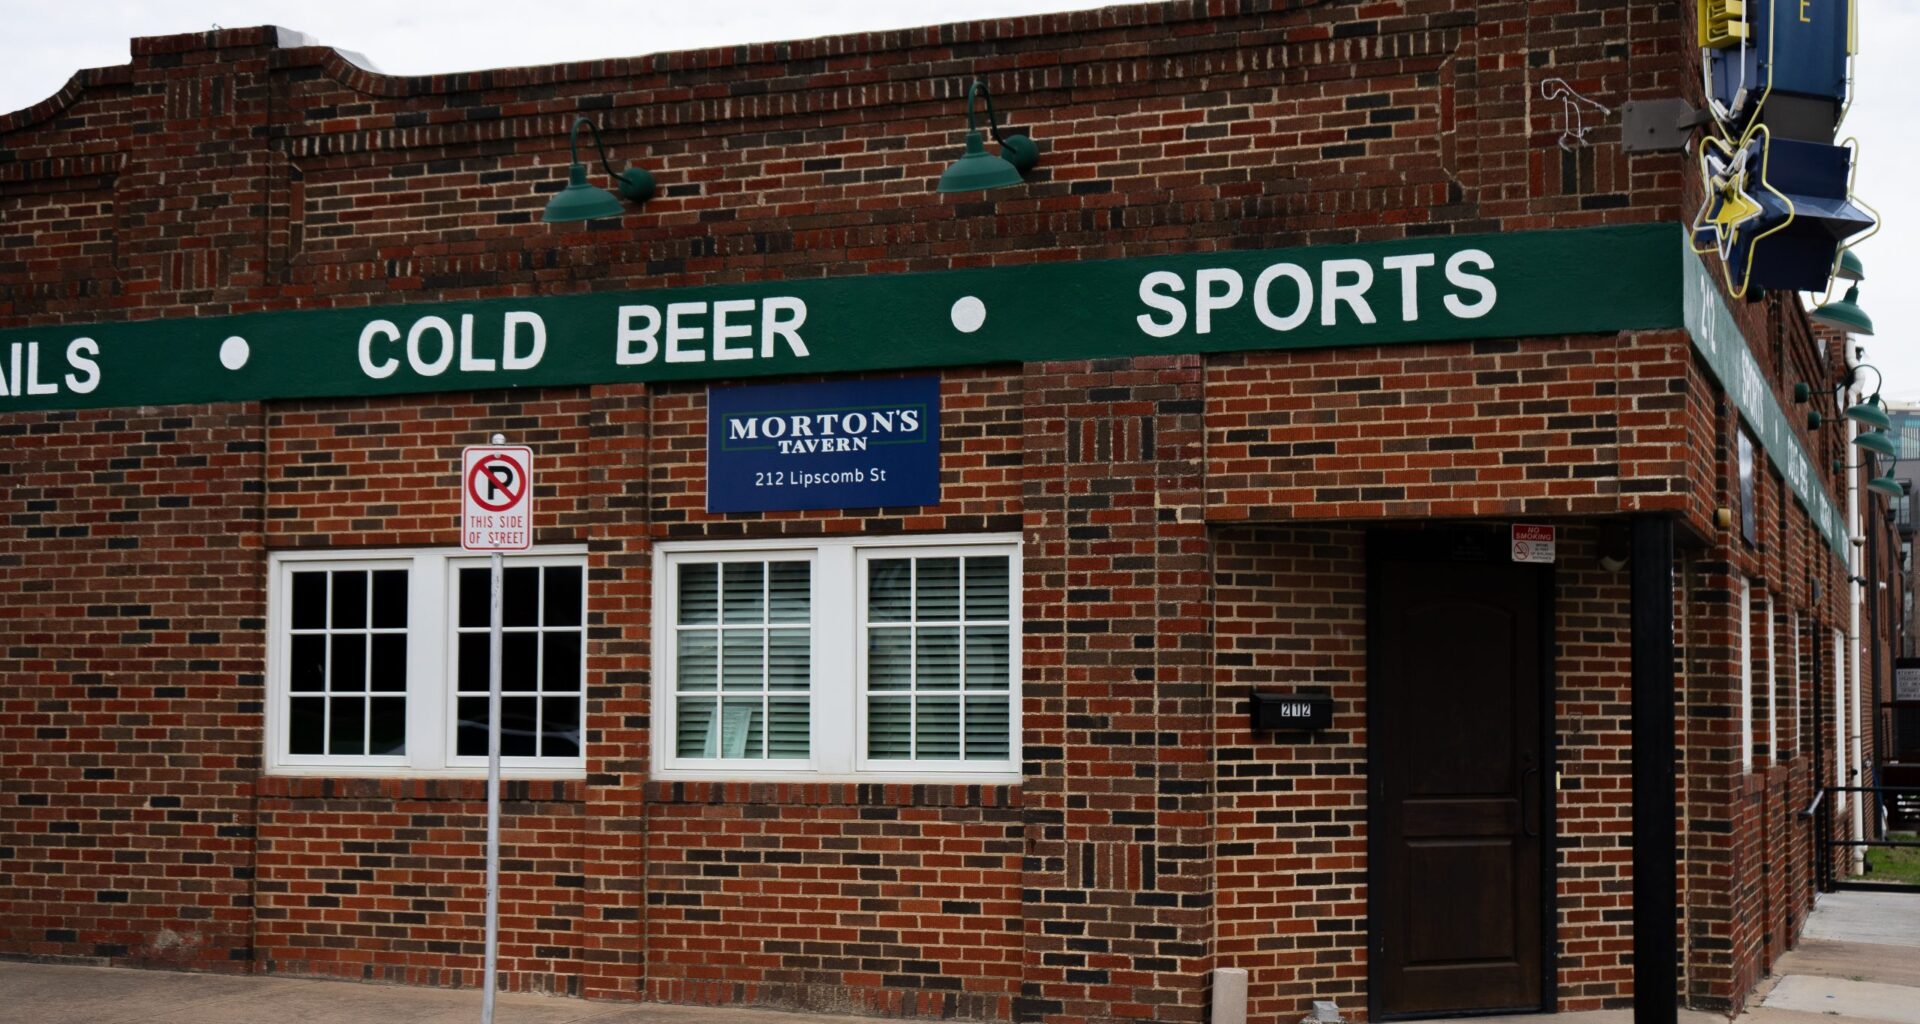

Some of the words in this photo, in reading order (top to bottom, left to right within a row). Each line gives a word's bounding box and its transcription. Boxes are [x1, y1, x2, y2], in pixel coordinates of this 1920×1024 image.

[0, 338, 100, 397] ILS
[358, 311, 547, 379] COLD
[615, 296, 810, 366] BEER
[1137, 249, 1497, 338] SPORTS
[1700, 274, 1716, 355] 212
[729, 409, 919, 440] MORTON'S
[778, 436, 868, 454] TAVERN
[755, 472, 785, 486] 212
[790, 468, 864, 488] Lipscomb
[870, 467, 887, 482] St
[470, 515, 493, 528] THIS
[499, 515, 523, 528] SIDE
[469, 531, 481, 544] OF
[488, 531, 525, 544] STREET
[1516, 532, 1552, 541] SMOKING
[1281, 703, 1311, 717] 212
